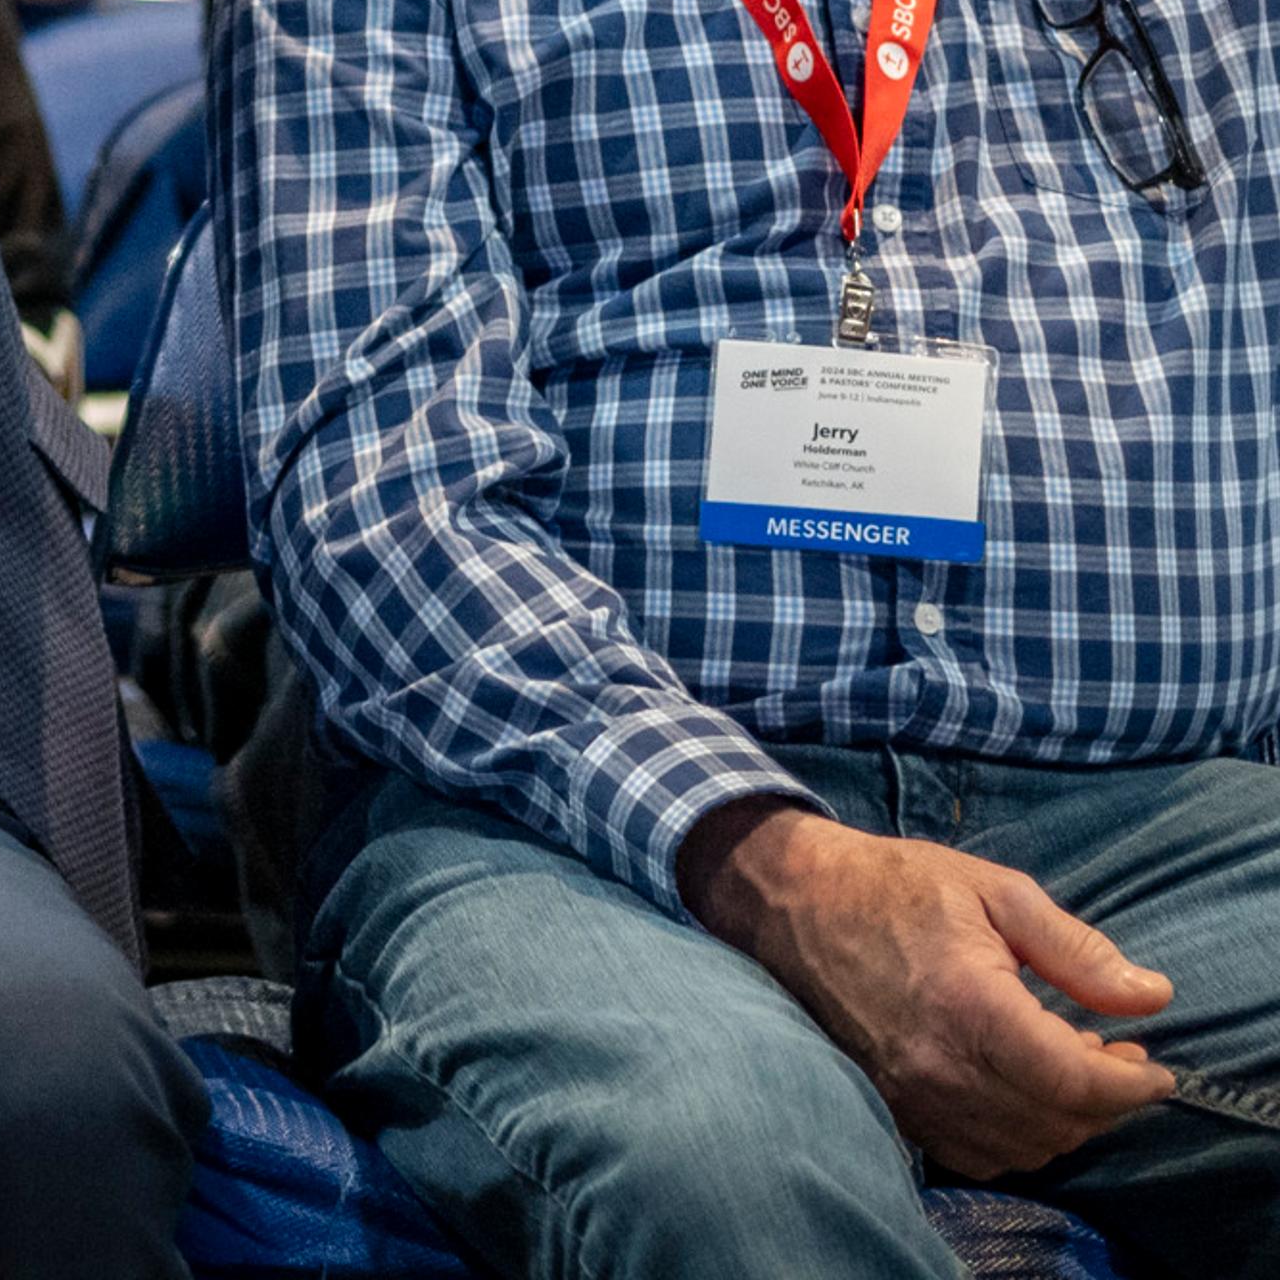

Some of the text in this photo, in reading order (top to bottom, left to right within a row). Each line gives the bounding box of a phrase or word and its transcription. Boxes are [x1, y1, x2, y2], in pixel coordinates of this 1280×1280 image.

[742, 367, 804, 380] ONE MIND
[867, 369, 906, 381] ANNUAL
[907, 373, 950, 385] MEETING
[741, 377, 808, 390] ONE VOICE
[875, 381, 938, 394] CONFERENCE
[818, 392, 837, 401] June
[811, 421, 859, 444] Jerry
[803, 444, 867, 457] Holderman
[766, 517, 910, 545] MESSENGER
